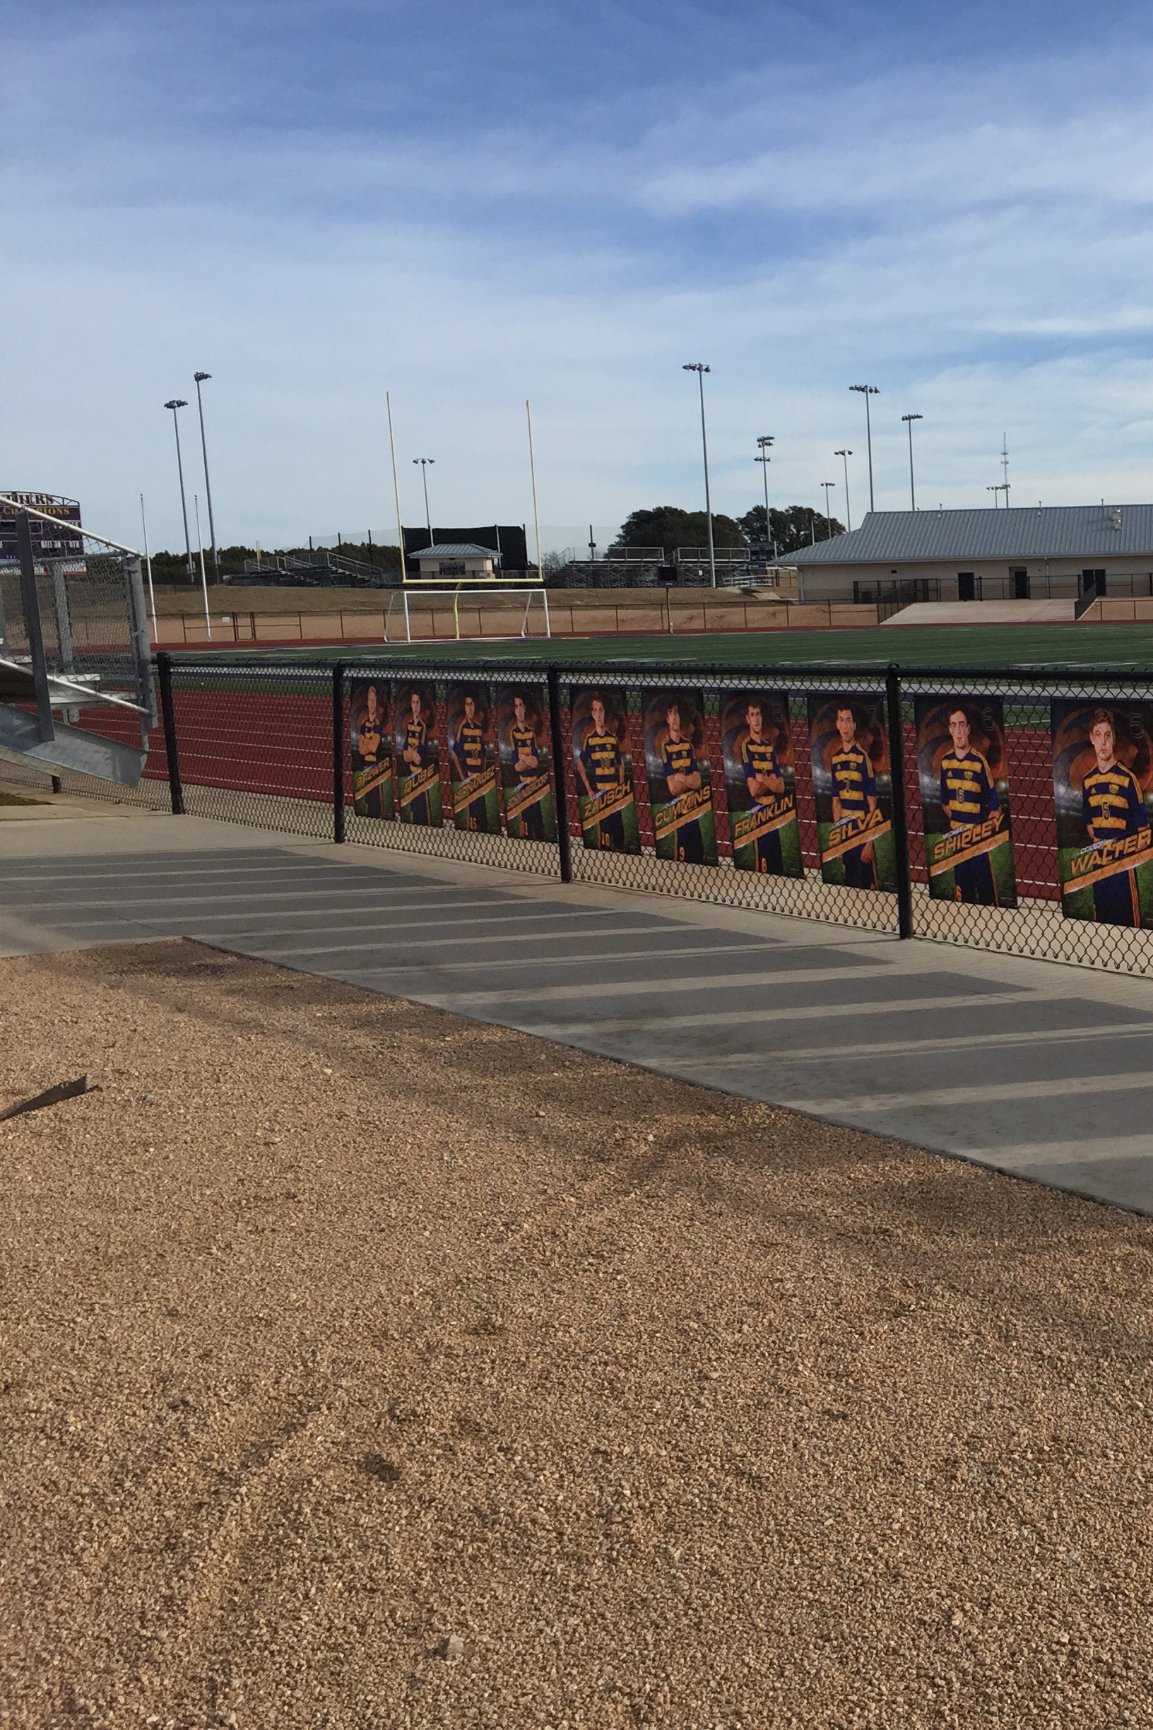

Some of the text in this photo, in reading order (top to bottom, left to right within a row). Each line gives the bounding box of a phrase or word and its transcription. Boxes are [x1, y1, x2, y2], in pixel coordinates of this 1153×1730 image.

[584, 780, 631, 817] ZAUSCH
[655, 785, 711, 826] CUMMINS
[735, 793, 793, 837] FRANKLIN
[1101, 801, 1111, 820] 5
[601, 831, 611, 847] 10
[829, 808, 884, 847] SILVA
[934, 813, 1005, 860] SHIPLEY
[678, 846, 685, 861] 9
[760, 856, 768, 873] 8
[1071, 828, 1152, 874] WALTER
[955, 885, 962, 902] 6
